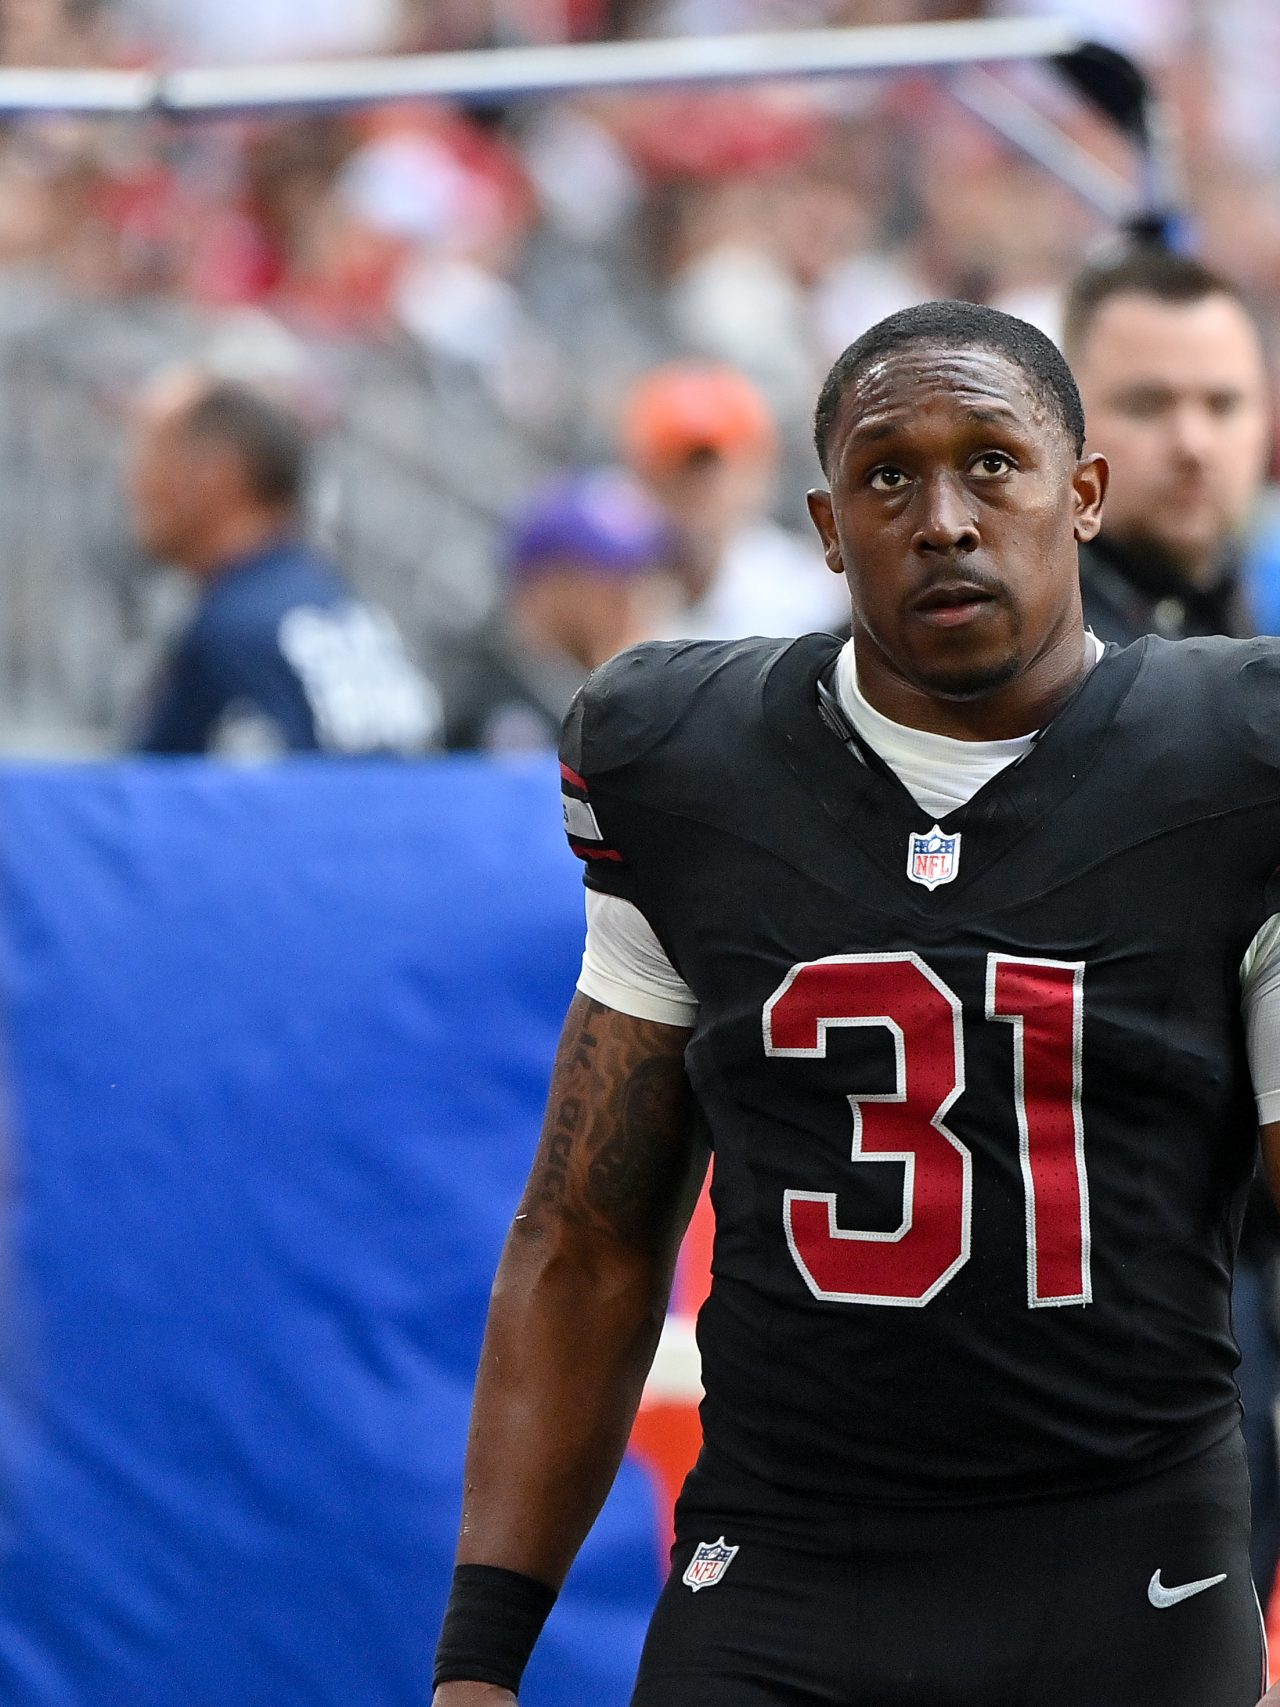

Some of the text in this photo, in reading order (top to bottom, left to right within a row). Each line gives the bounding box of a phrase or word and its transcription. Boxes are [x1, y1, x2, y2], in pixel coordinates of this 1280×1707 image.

[916, 855, 950, 879] NFL
[762, 950, 1094, 1309] 31
[689, 1561, 720, 1581] NFL
